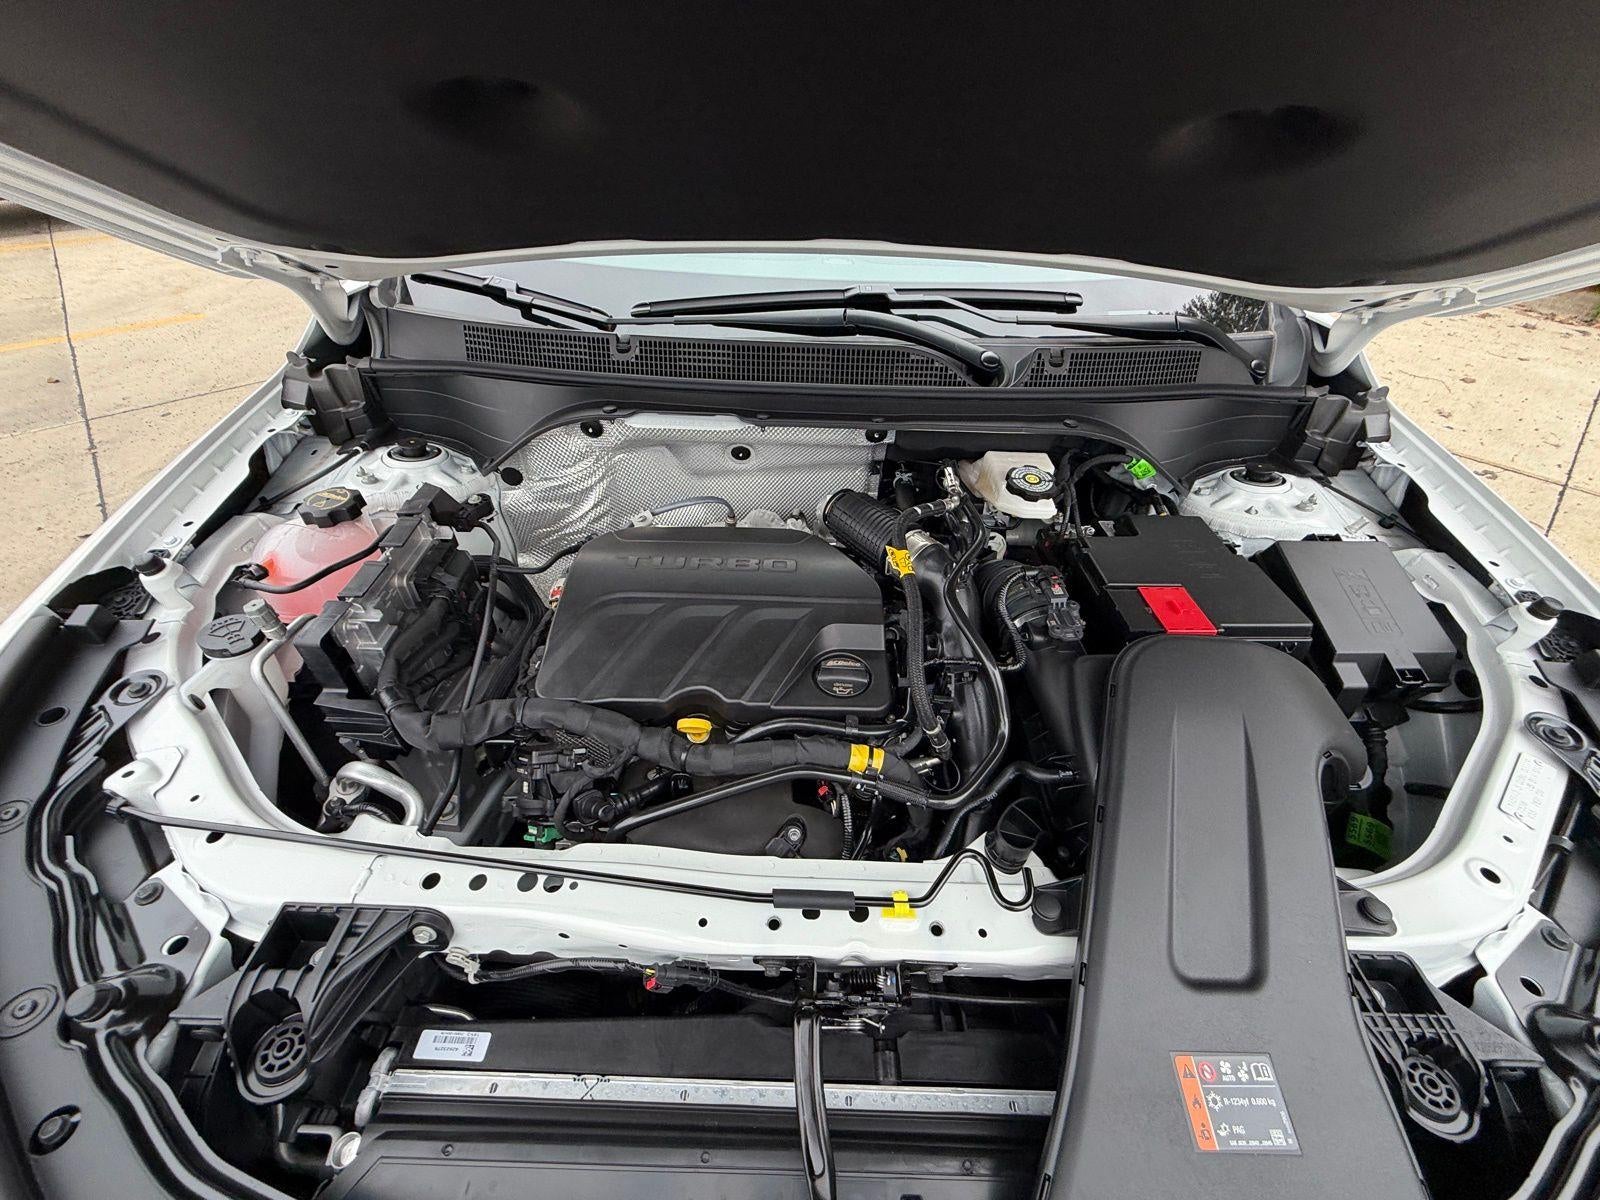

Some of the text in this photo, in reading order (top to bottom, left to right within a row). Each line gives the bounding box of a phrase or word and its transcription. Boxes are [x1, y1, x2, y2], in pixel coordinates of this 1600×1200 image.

[617, 555, 797, 573] TURBO
[826, 659, 861, 667] ACDelco
[1232, 1125, 1246, 1135] PAG
